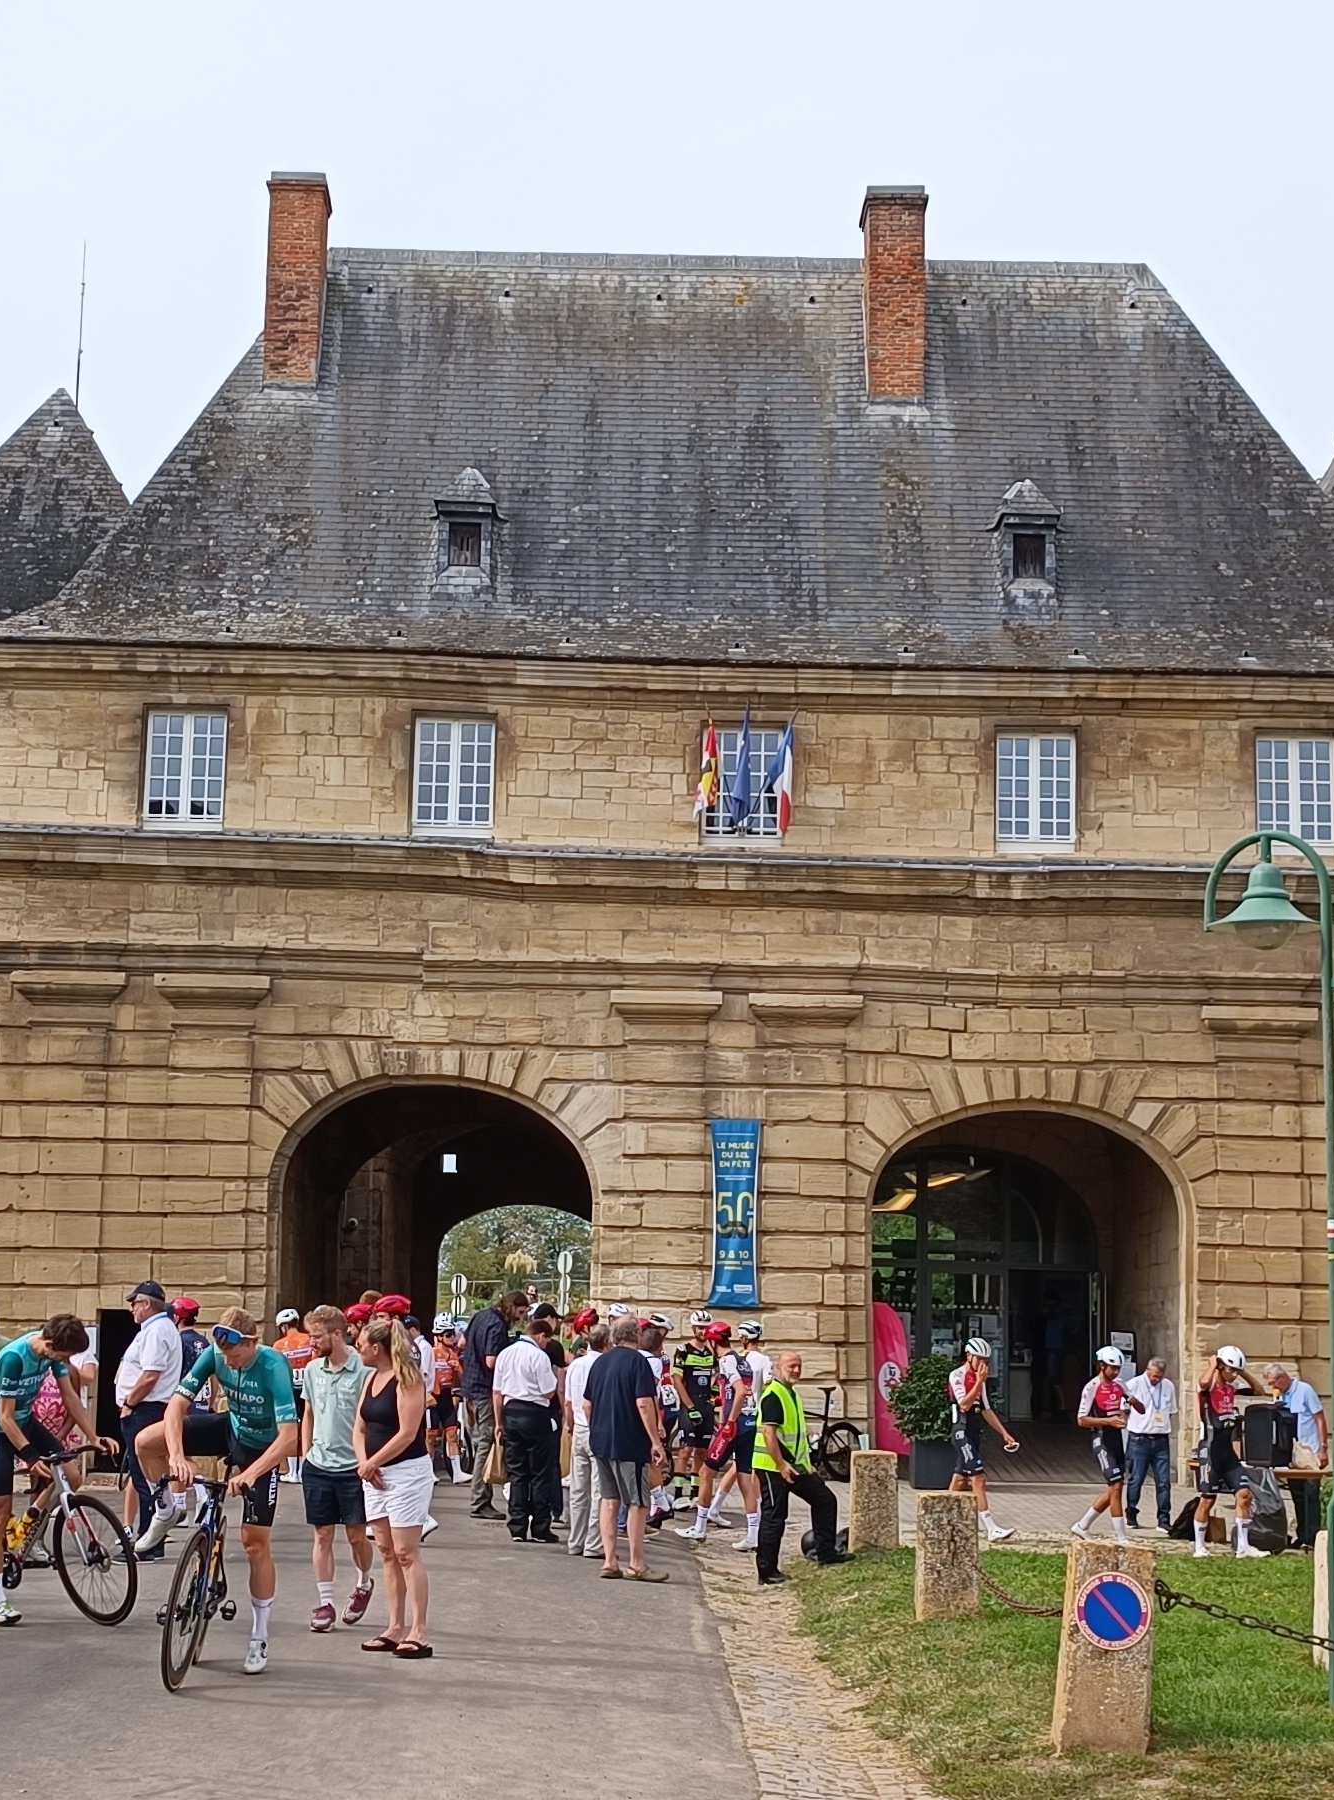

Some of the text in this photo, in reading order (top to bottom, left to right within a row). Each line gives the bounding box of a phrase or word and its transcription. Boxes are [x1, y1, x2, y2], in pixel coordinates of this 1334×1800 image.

[728, 1141, 754, 1149] MUSÉE
[732, 1160, 752, 1168] FÊTE
[717, 1191, 753, 1234] 50
[719, 1250, 726, 1258] 9
